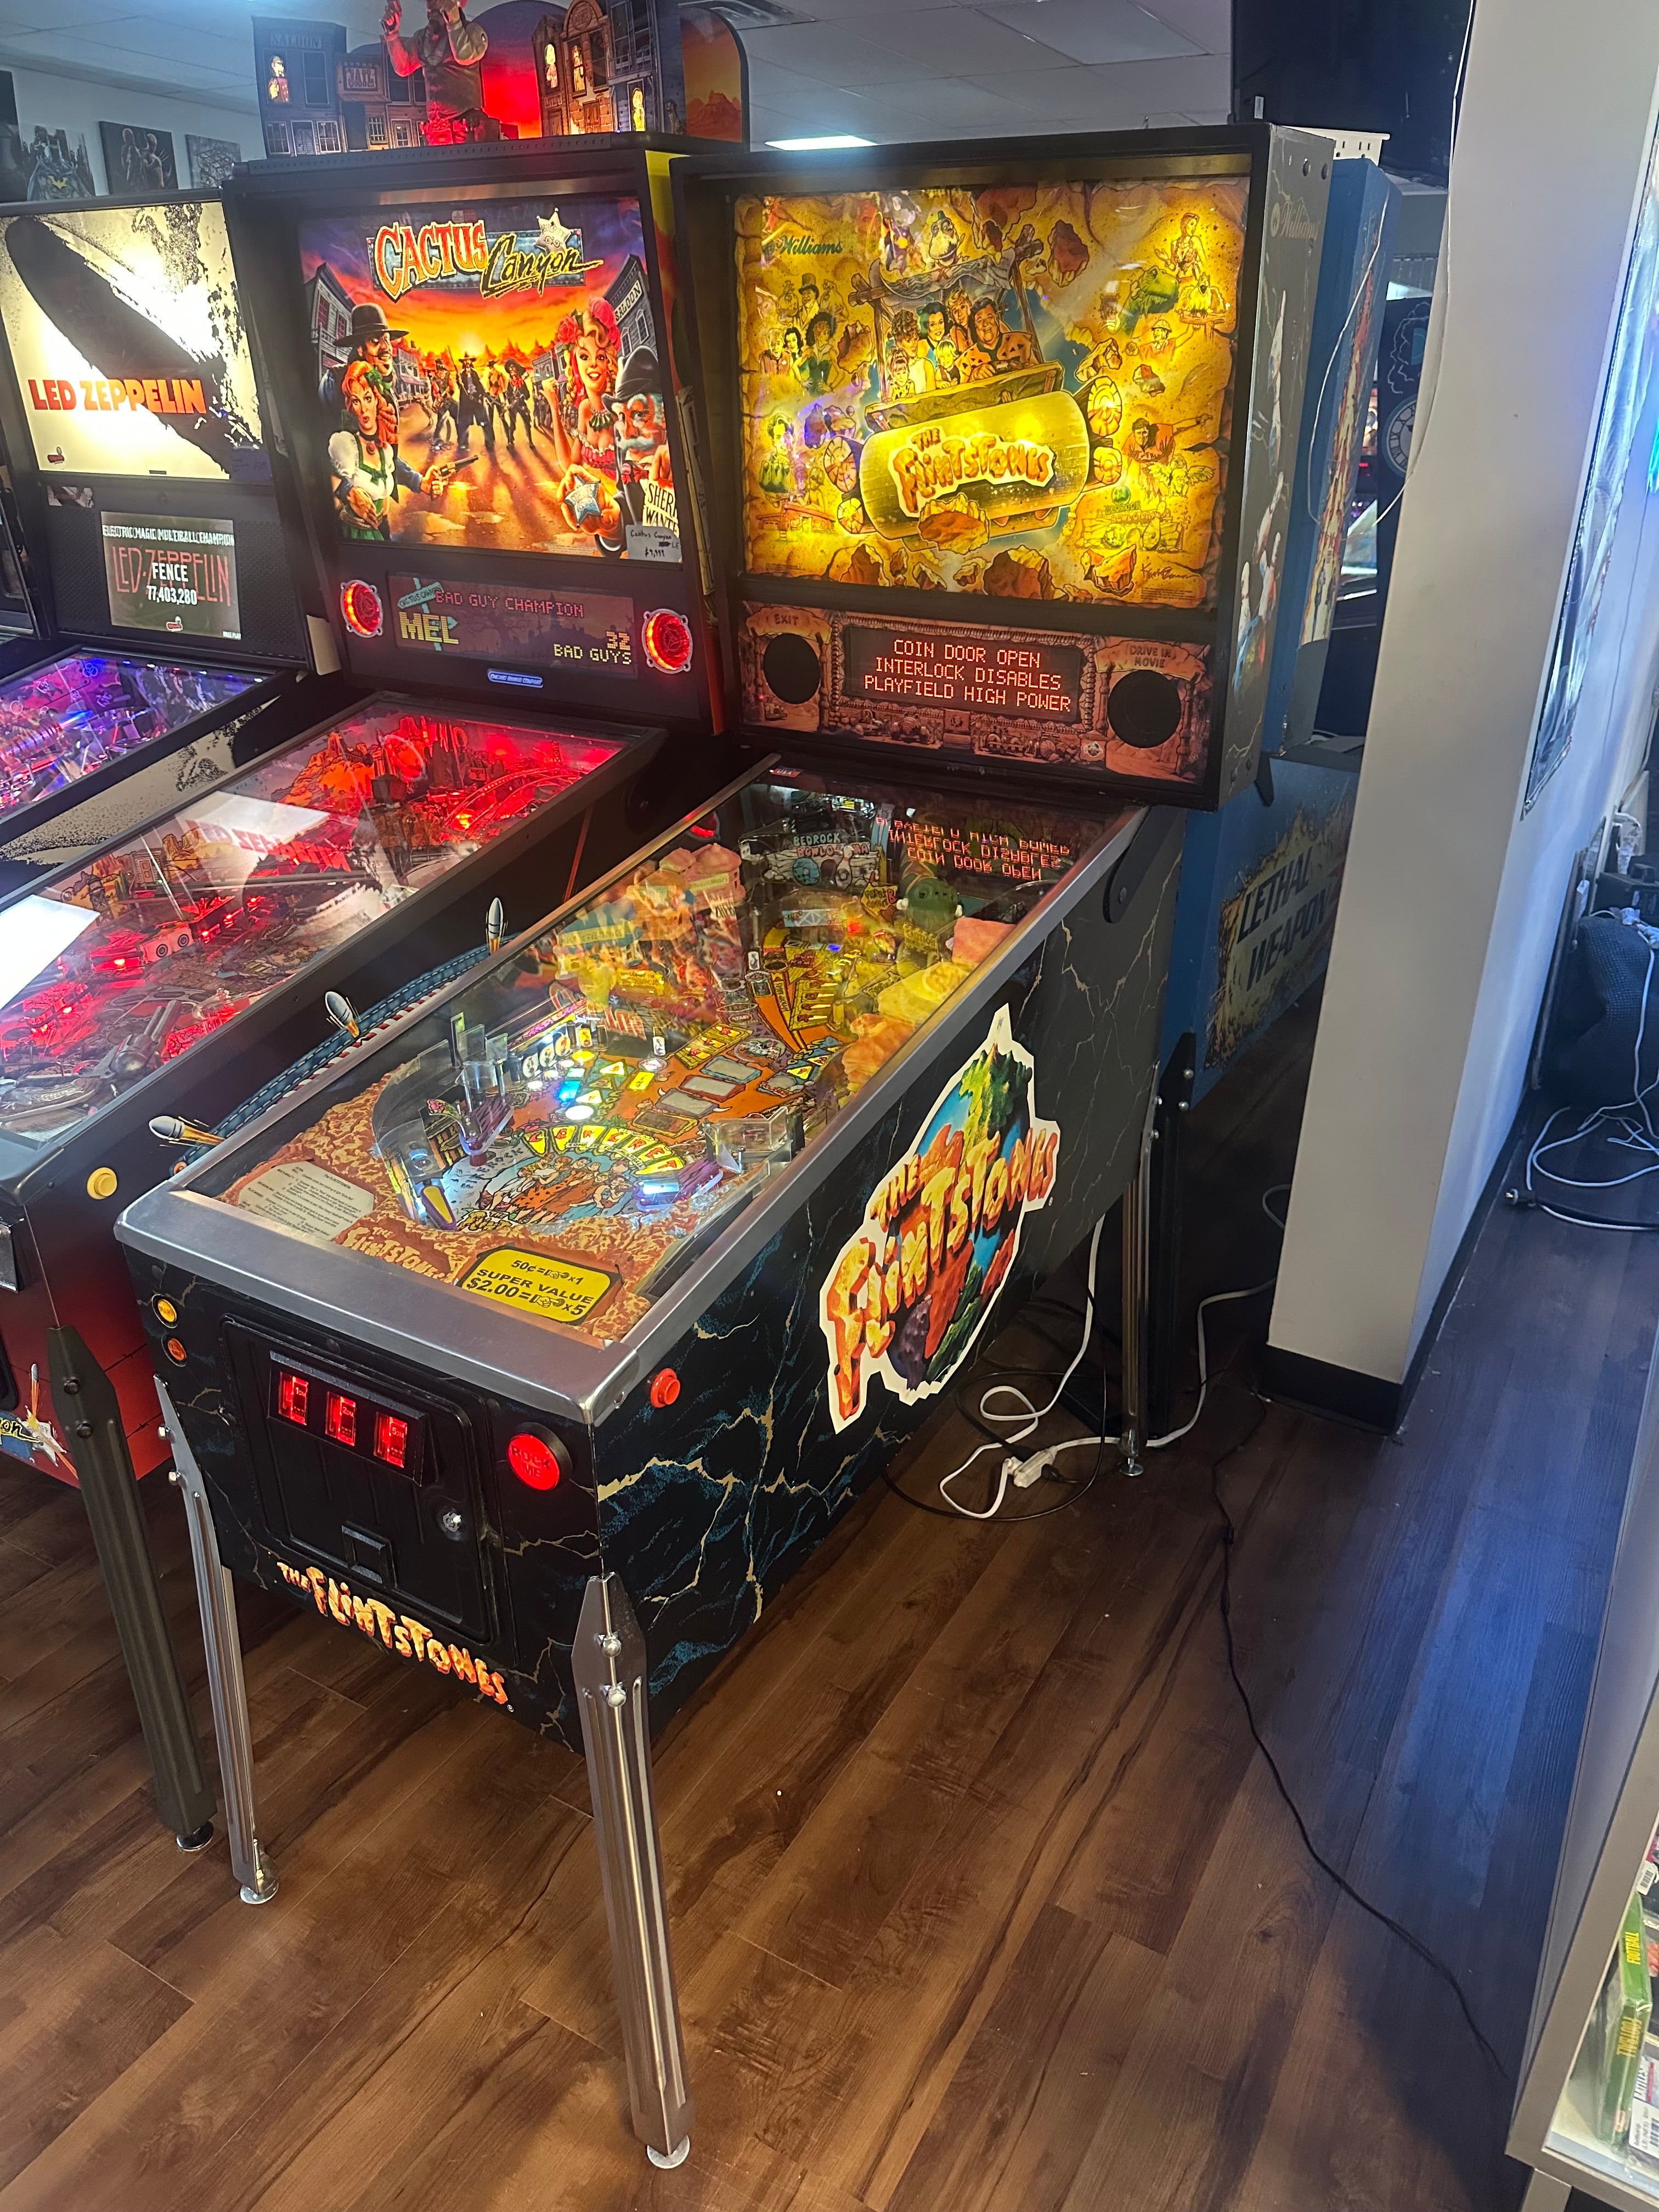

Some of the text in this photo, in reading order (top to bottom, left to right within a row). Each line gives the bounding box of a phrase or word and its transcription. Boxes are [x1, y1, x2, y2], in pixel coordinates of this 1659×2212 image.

[348, 68, 375, 88] JAIL
[776, 235, 843, 255] Williams
[375, 220, 488, 302] CACTUS
[481, 233, 603, 299] Canyon
[615, 283, 641, 321] SALOON
[28, 379, 207, 414] LED ZEPPELIN
[912, 428, 941, 452] THE
[893, 436, 1049, 513] FLINTSTONES
[103, 524, 235, 547] ELECTRIC MAGIC MULTIBALL CHAMPION
[152, 562, 189, 582] FENCE
[146, 585, 198, 606] 77,403,280
[436, 590, 585, 618] BAD GUY CHAMPION
[399, 612, 459, 645] MEL
[774, 614, 799, 625] EXIT
[554, 644, 633, 665] BAD GUYS
[606, 630, 631, 652] 32
[894, 639, 1040, 668] COIN DOOR OPEN
[1130, 646, 1172, 658] DRIVE IN
[876, 657, 1062, 691] INTERLOCK DISABLES
[1135, 659, 1165, 668] MOVIE
[864, 675, 1071, 712] PLAYFIELD HIGH POWER
[793, 833, 840, 847] BEDROCK
[1237, 846, 1313, 944] LETHAL
[1246, 886, 1329, 992] WEAPON
[870, 1153, 921, 1232] THE
[373, 1226, 393, 1238] THE
[477, 1269, 594, 1304] SUPER VALUE
[827, 1127, 1058, 1421] FLINTSTONES
[562, 1304, 586, 1316] x5
[342, 1406, 354, 1417] 2DM
[392, 1427, 404, 1438] 5DM
[511, 1444, 550, 1470] ROCK
[522, 1463, 541, 1477] ME
[276, 1561, 311, 1593] THE
[306, 1566, 509, 1705] FLINTSTONES
[1625, 1931, 1641, 1965] FOOTBALL
